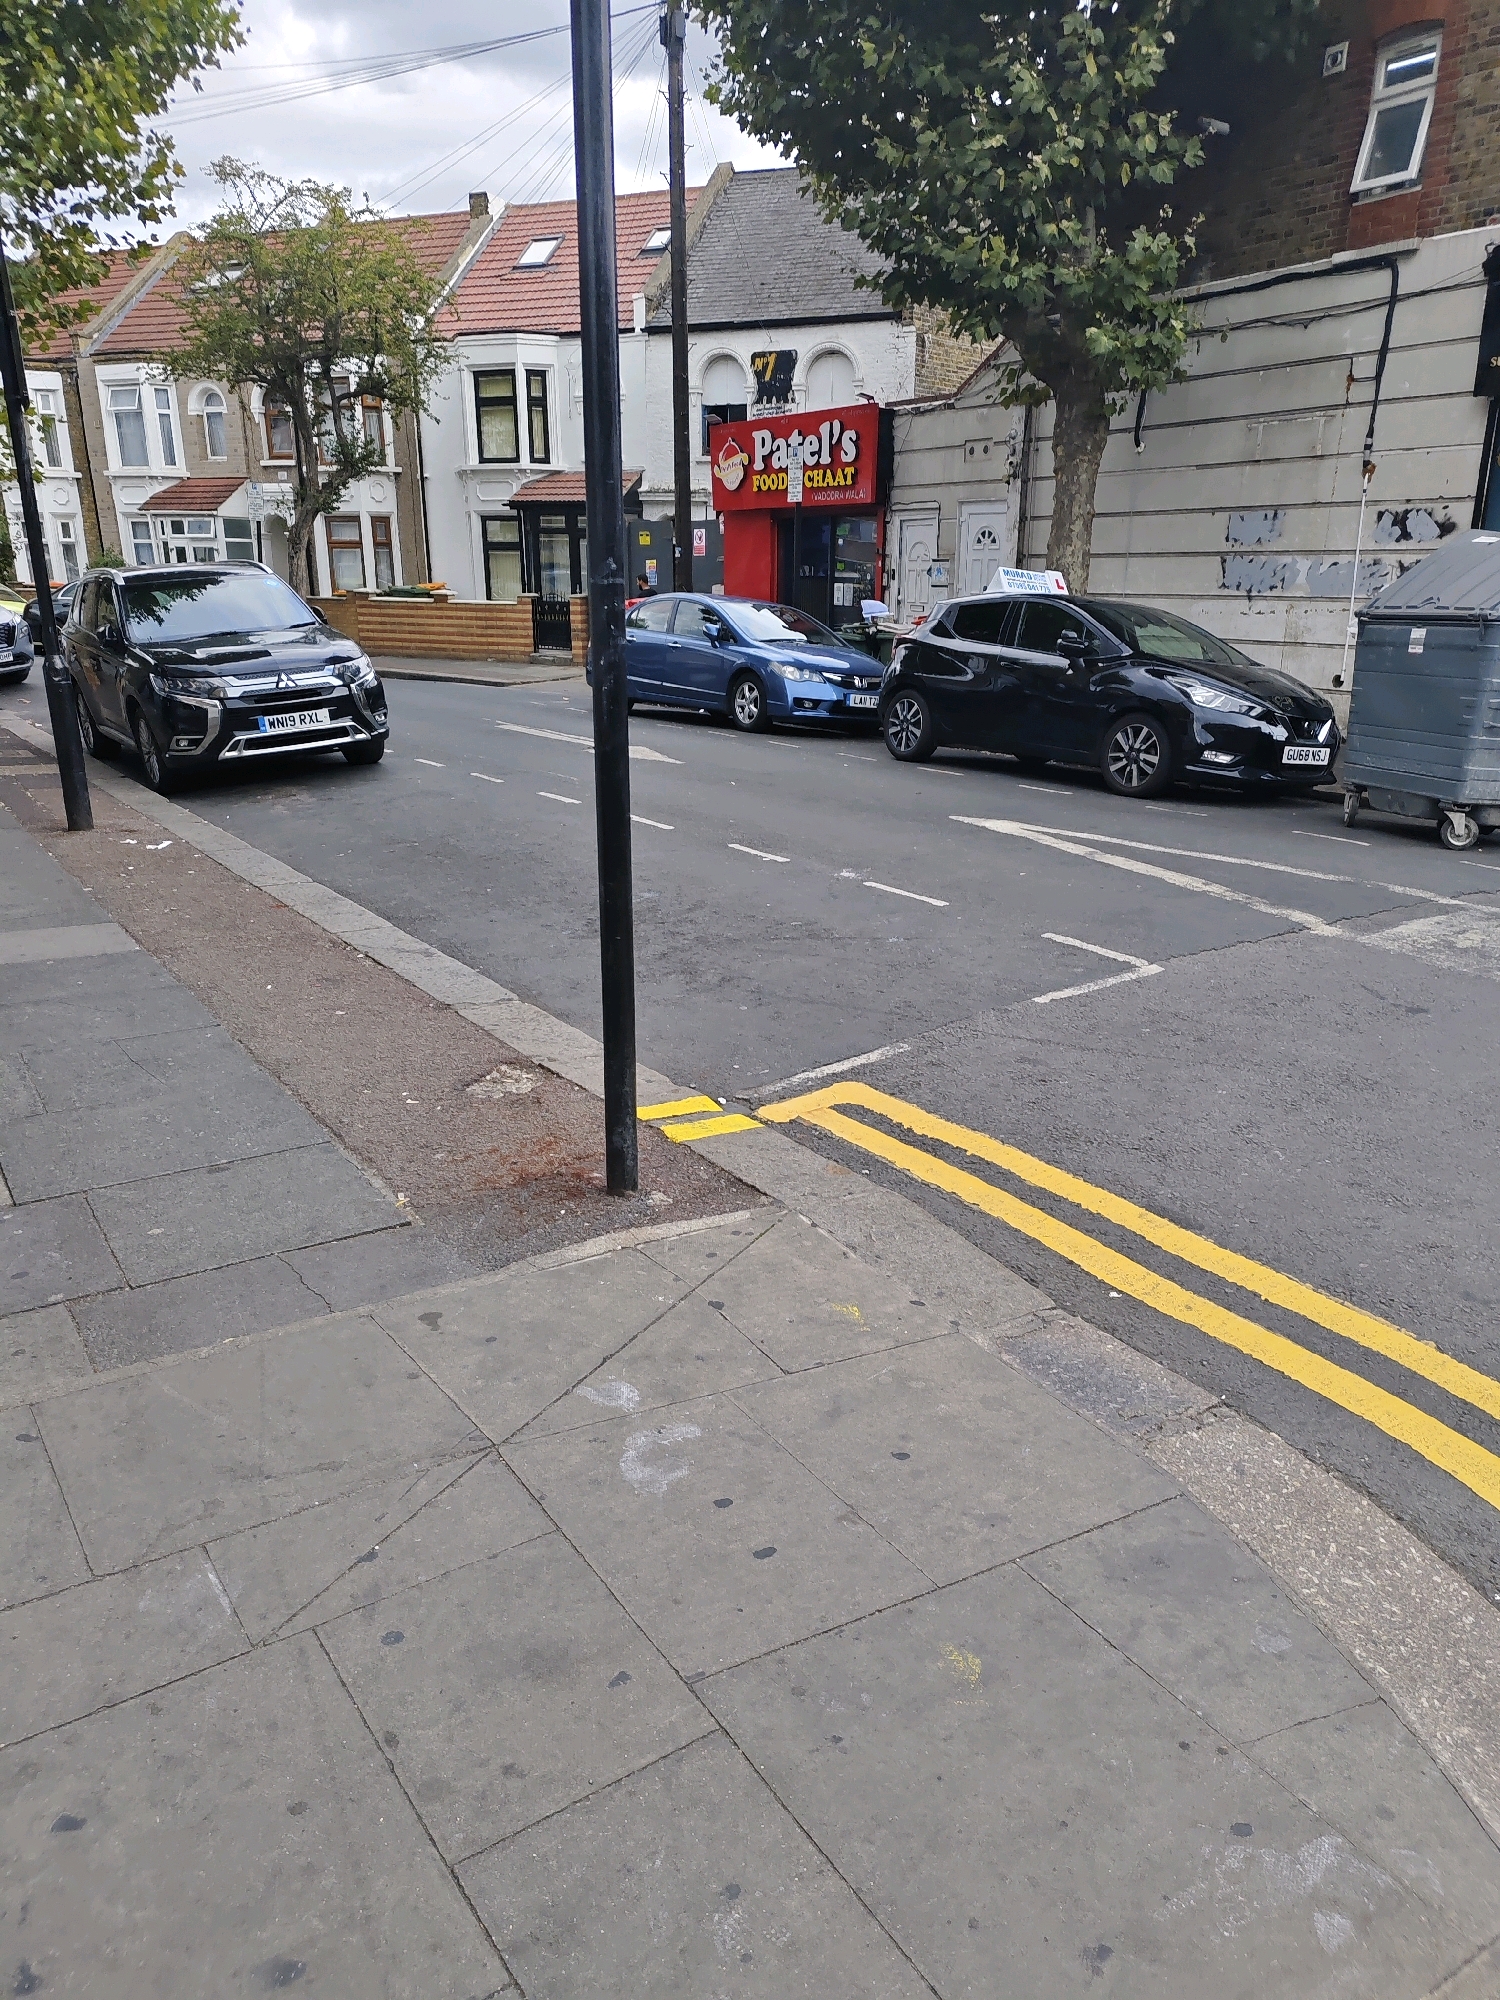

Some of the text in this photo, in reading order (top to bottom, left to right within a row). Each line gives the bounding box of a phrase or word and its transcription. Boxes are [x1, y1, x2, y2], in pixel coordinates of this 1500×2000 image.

[751, 419, 857, 471] Patel's
[752, 472, 788, 492] FOOD
[803, 466, 855, 488] CHAAT
[268, 715, 296, 729] WN19
[299, 712, 323, 725] RXL
[1287, 749, 1326, 761] GU68 NSJ
